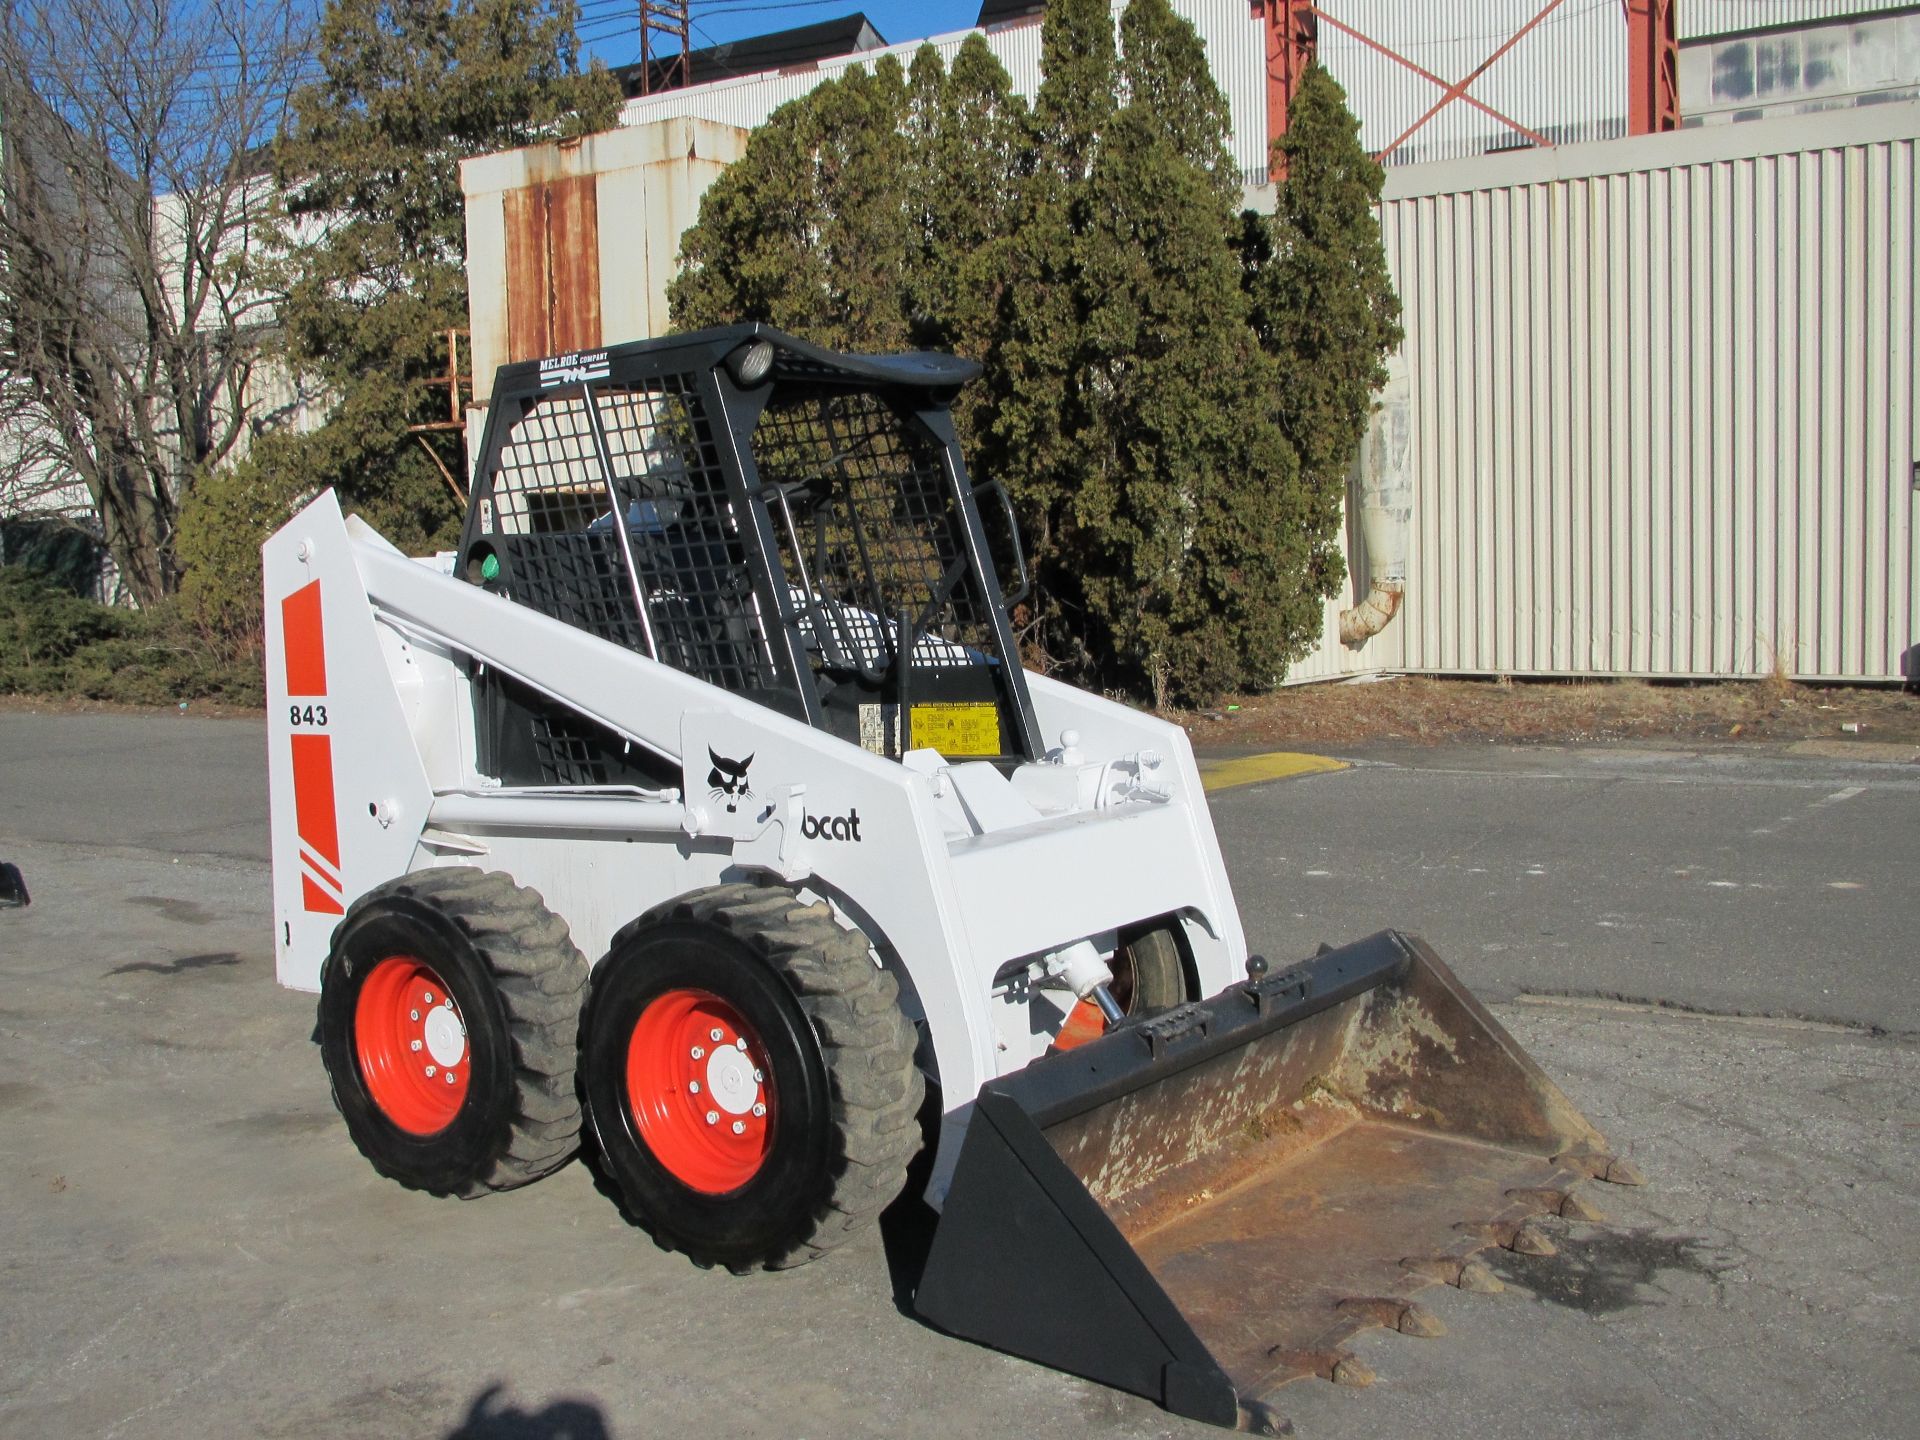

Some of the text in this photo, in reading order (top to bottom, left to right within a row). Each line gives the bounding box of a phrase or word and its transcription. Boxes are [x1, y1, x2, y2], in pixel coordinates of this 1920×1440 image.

[540, 352, 608, 371] MELROE COMPANY
[290, 705, 328, 726] 843
[801, 807, 861, 842] bcat
